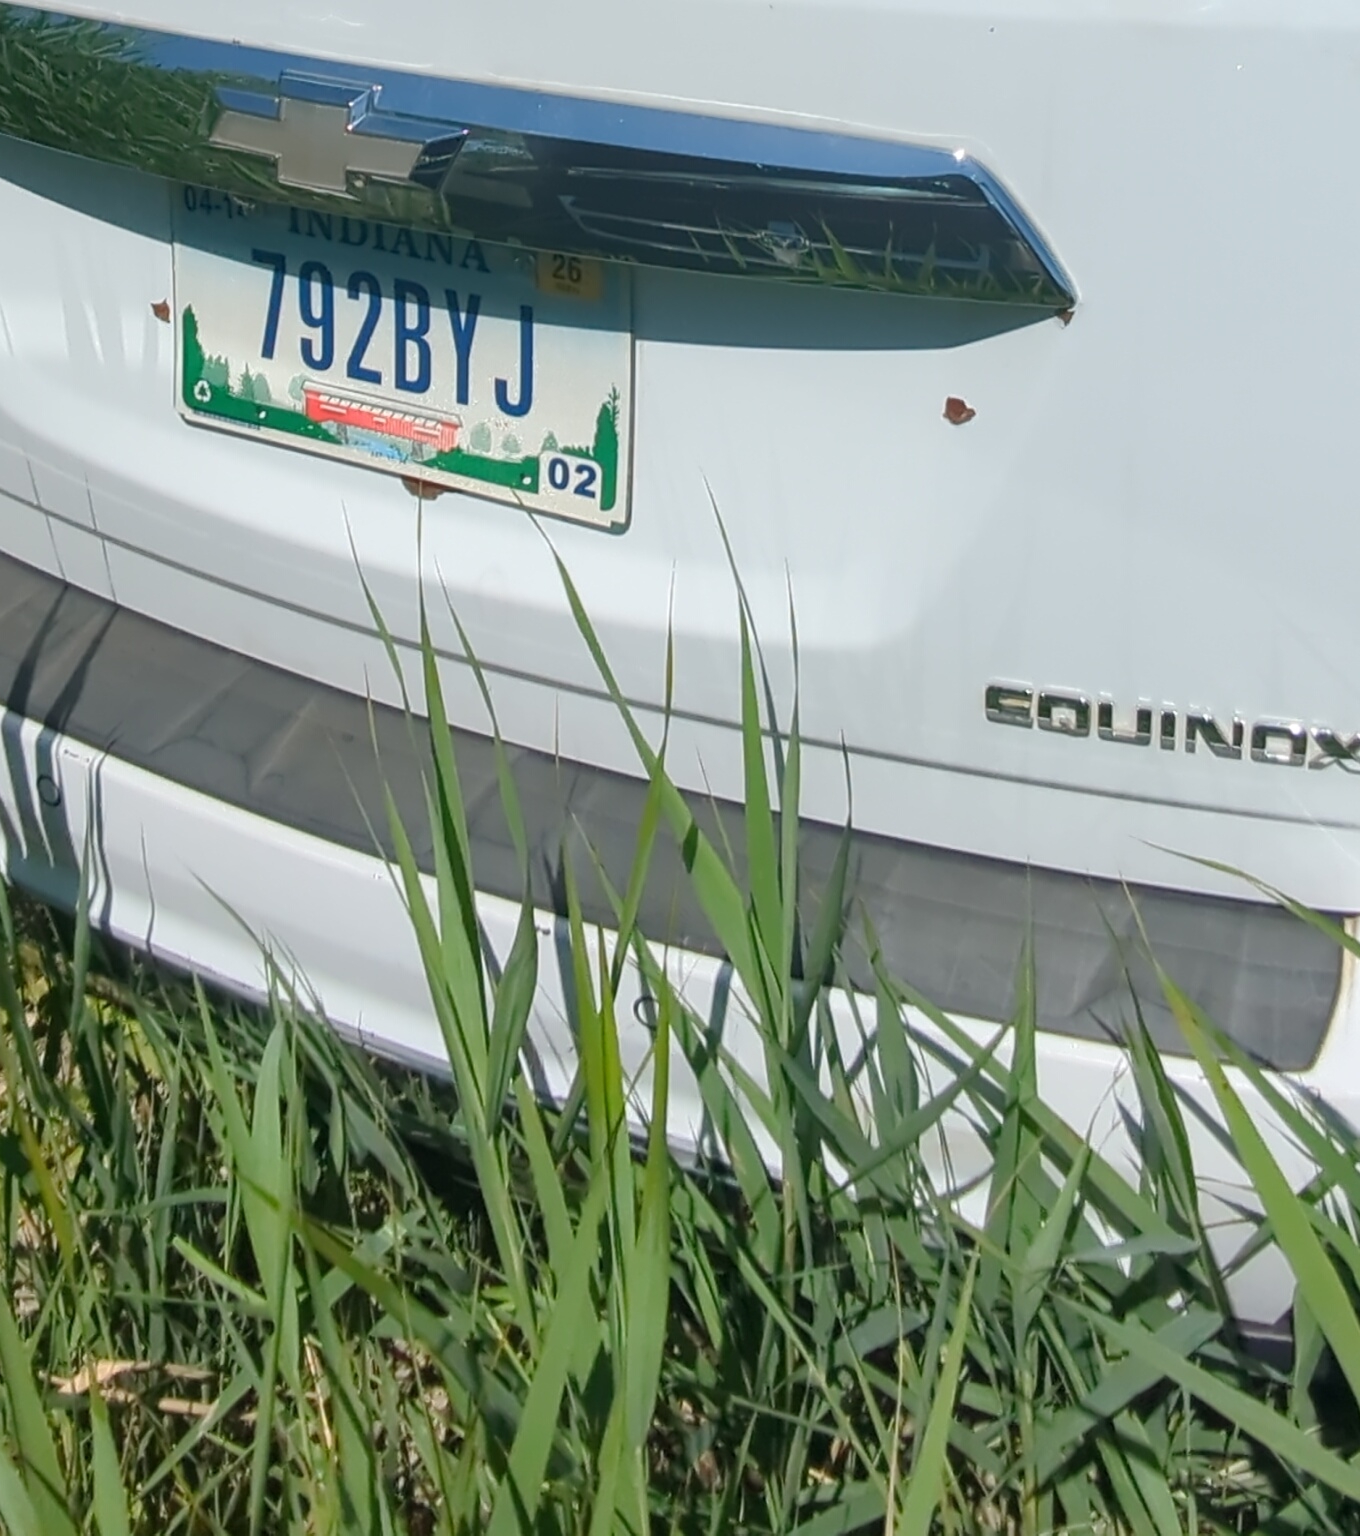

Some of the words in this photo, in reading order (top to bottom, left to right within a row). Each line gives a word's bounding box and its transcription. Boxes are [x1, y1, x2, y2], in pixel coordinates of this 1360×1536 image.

[288, 207, 491, 275] INDIANA
[551, 253, 583, 284] 26
[251, 247, 534, 418] 792BYJ
[546, 457, 597, 499] 02
